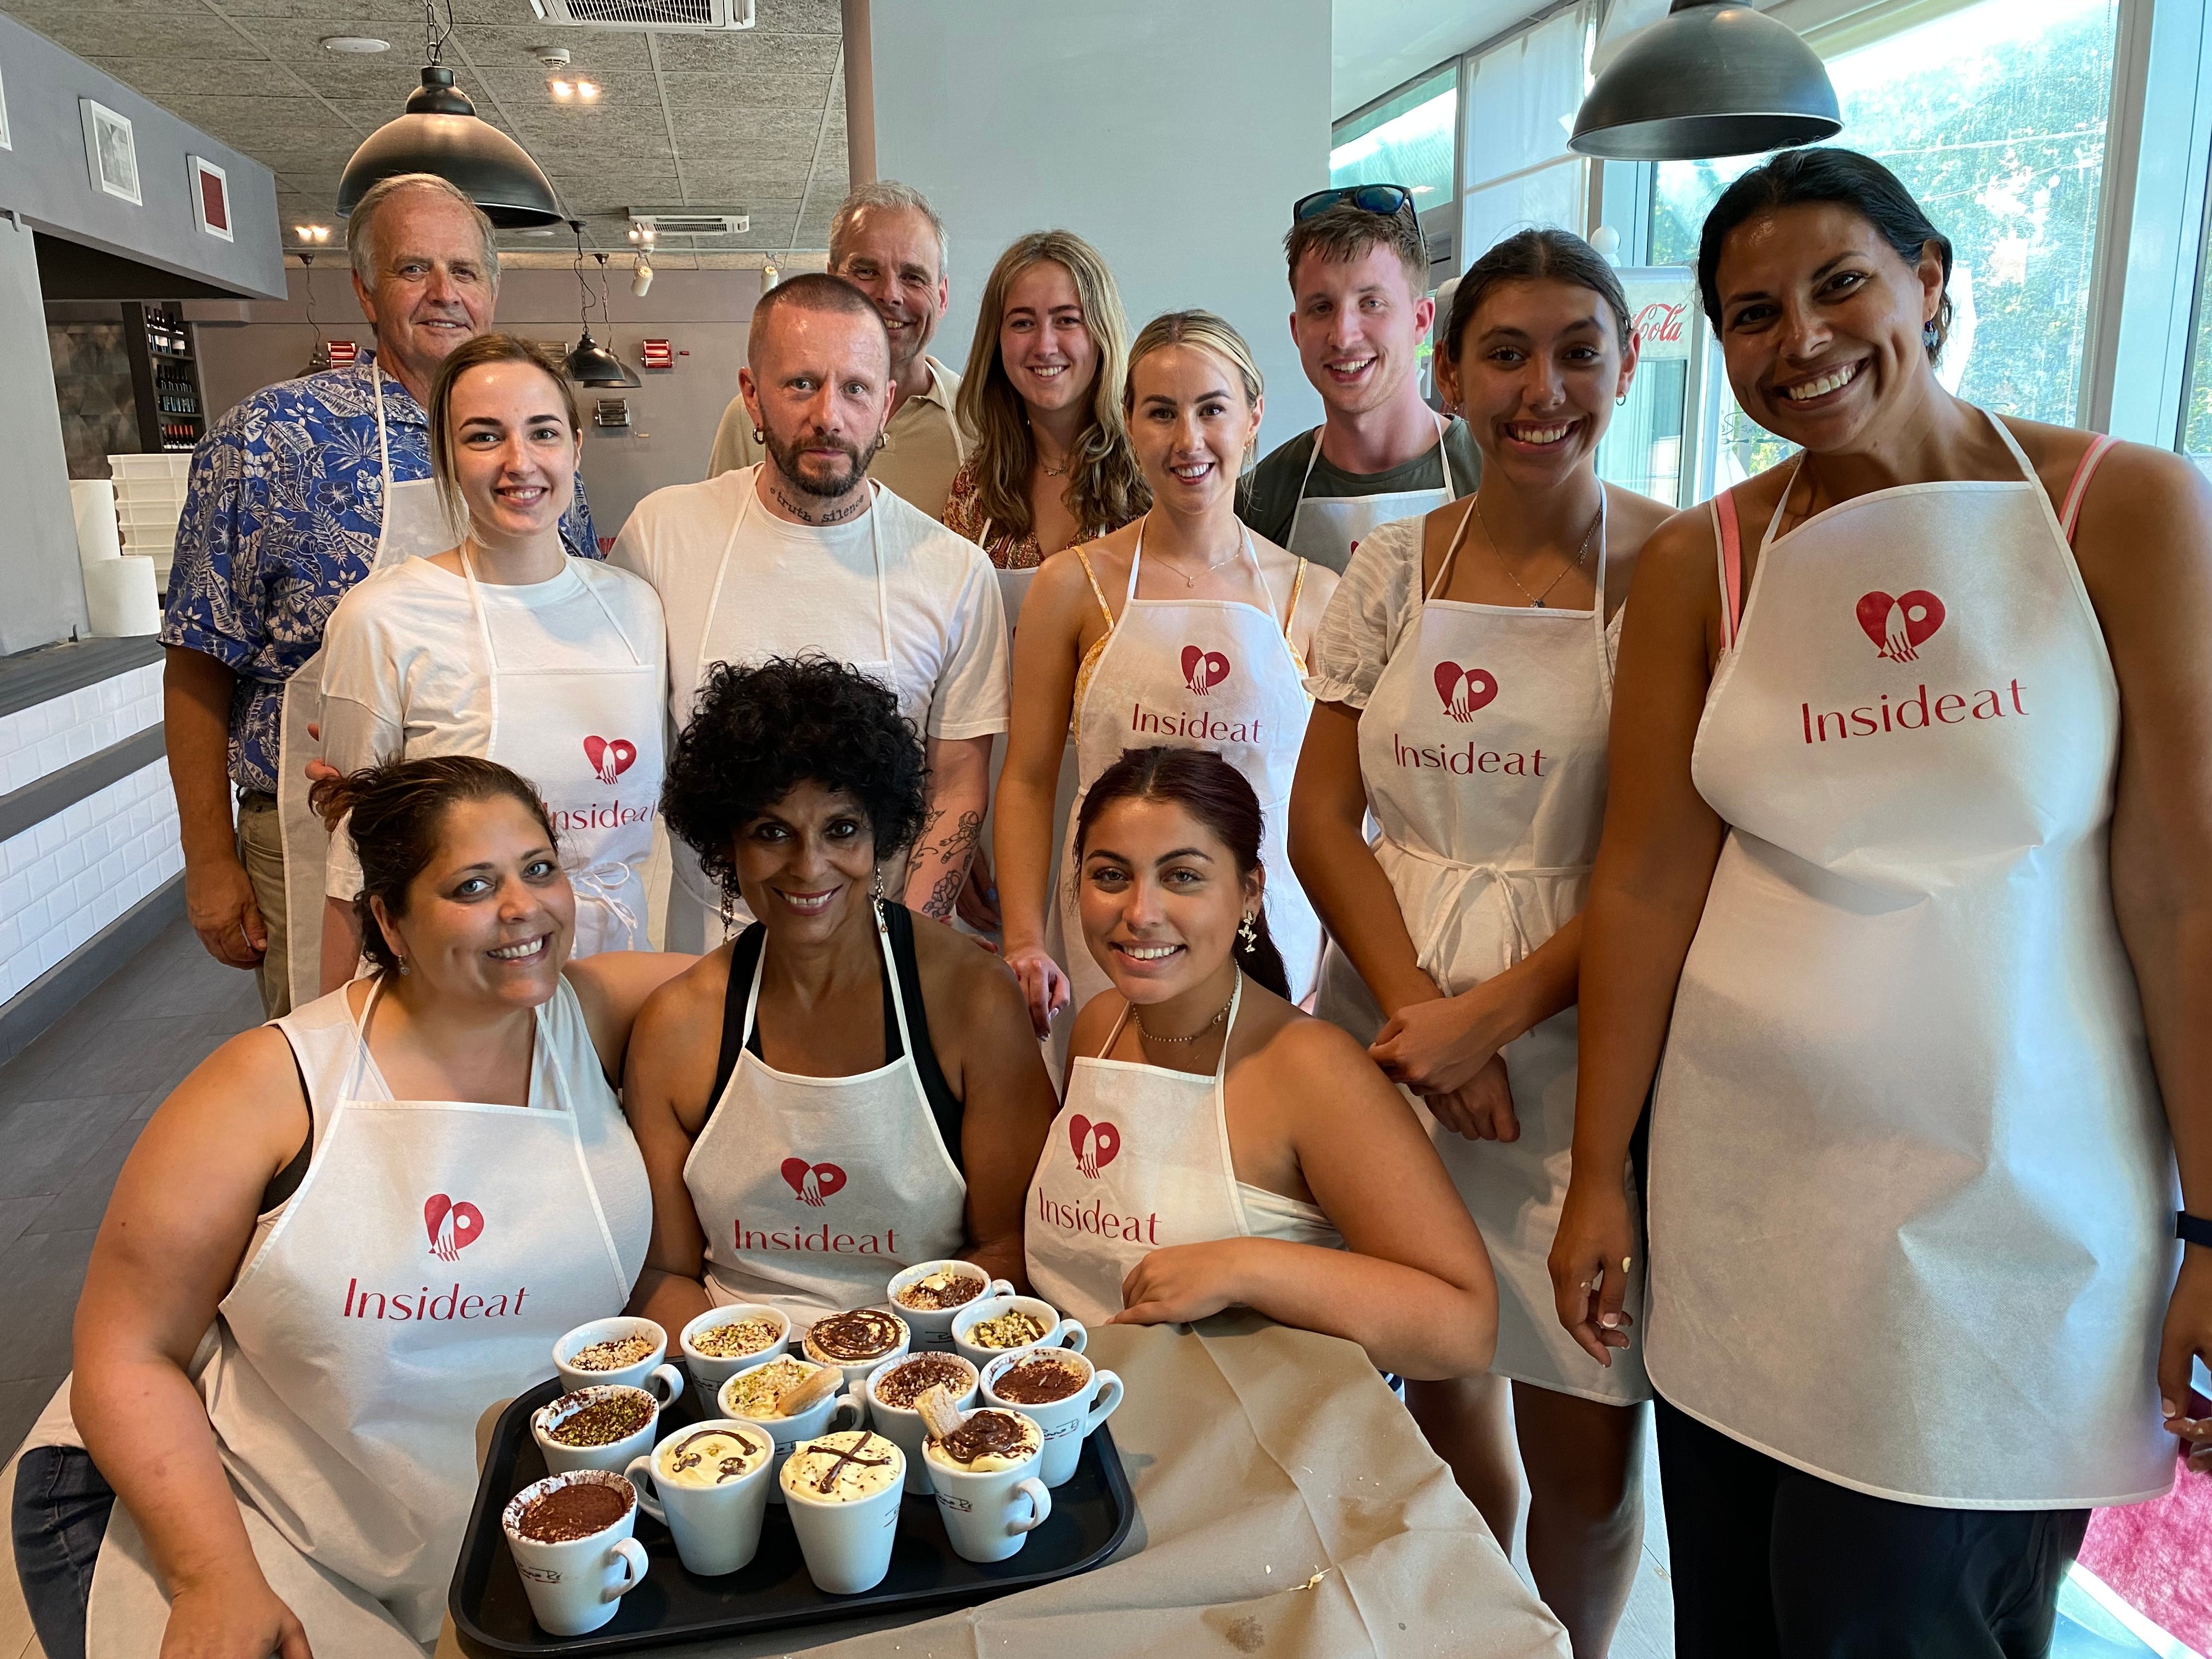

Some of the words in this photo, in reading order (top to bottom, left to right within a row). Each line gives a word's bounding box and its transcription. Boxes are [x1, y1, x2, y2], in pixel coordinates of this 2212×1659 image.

[776, 492, 812, 522] truth
[821, 495, 864, 523] silence
[1132, 703, 1263, 743] Insideat
[1802, 678, 2030, 744] Insideat
[1394, 733, 1547, 776] Insideat
[735, 1219, 900, 1254] Insideat
[1039, 1187, 1162, 1245] Insideat
[343, 1278, 531, 1321] Insideat
